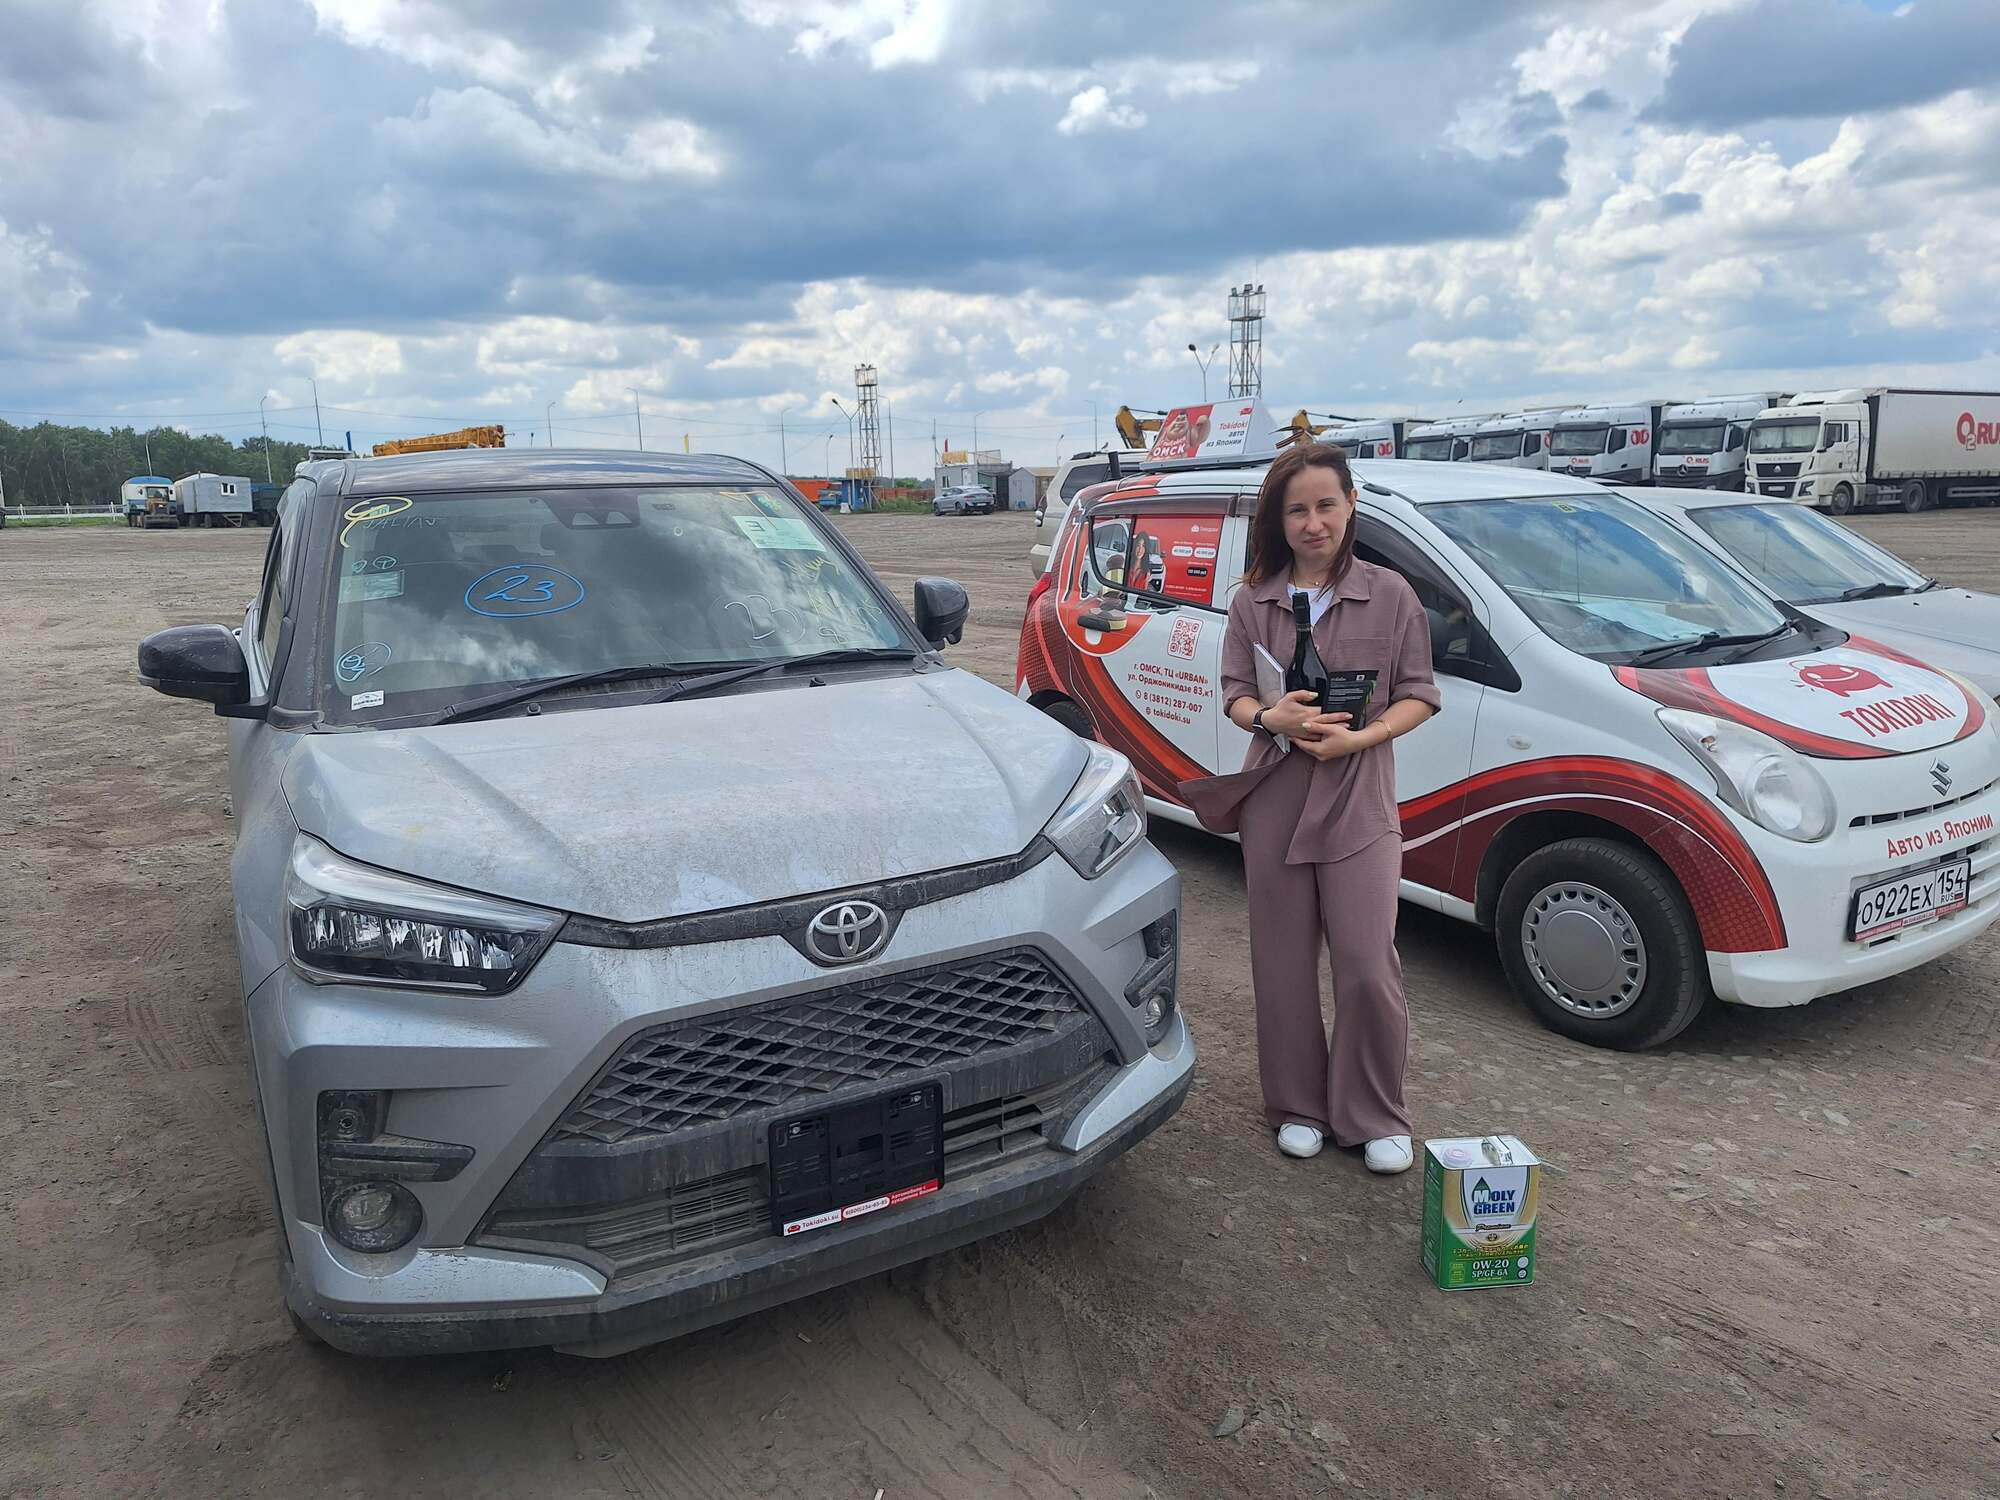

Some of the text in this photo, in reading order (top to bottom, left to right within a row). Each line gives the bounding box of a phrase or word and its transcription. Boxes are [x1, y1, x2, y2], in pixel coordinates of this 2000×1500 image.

[1153, 443, 1186, 457] ОМСК
[483, 574, 556, 602] 23
[1164, 668, 1174, 678] ТЦ
[1138, 674, 1192, 693] Орджоникидзе
[1148, 693, 1172, 707] (3812)
[1173, 699, 1202, 713] 287-007
[1153, 708, 1190, 724] tokidoki.su
[1839, 694, 1957, 738] TOKIDOKI
[1887, 814, 1994, 858] Авто из Японии
[1938, 867, 1966, 894] 154
[1940, 893, 1954, 904] RUS
[1473, 1190, 1516, 1203] MOLY
[1474, 1202, 1515, 1214] GREEN
[802, 1215, 839, 1228] Tokidoki.su
[1472, 1258, 1510, 1270] 0W-20
